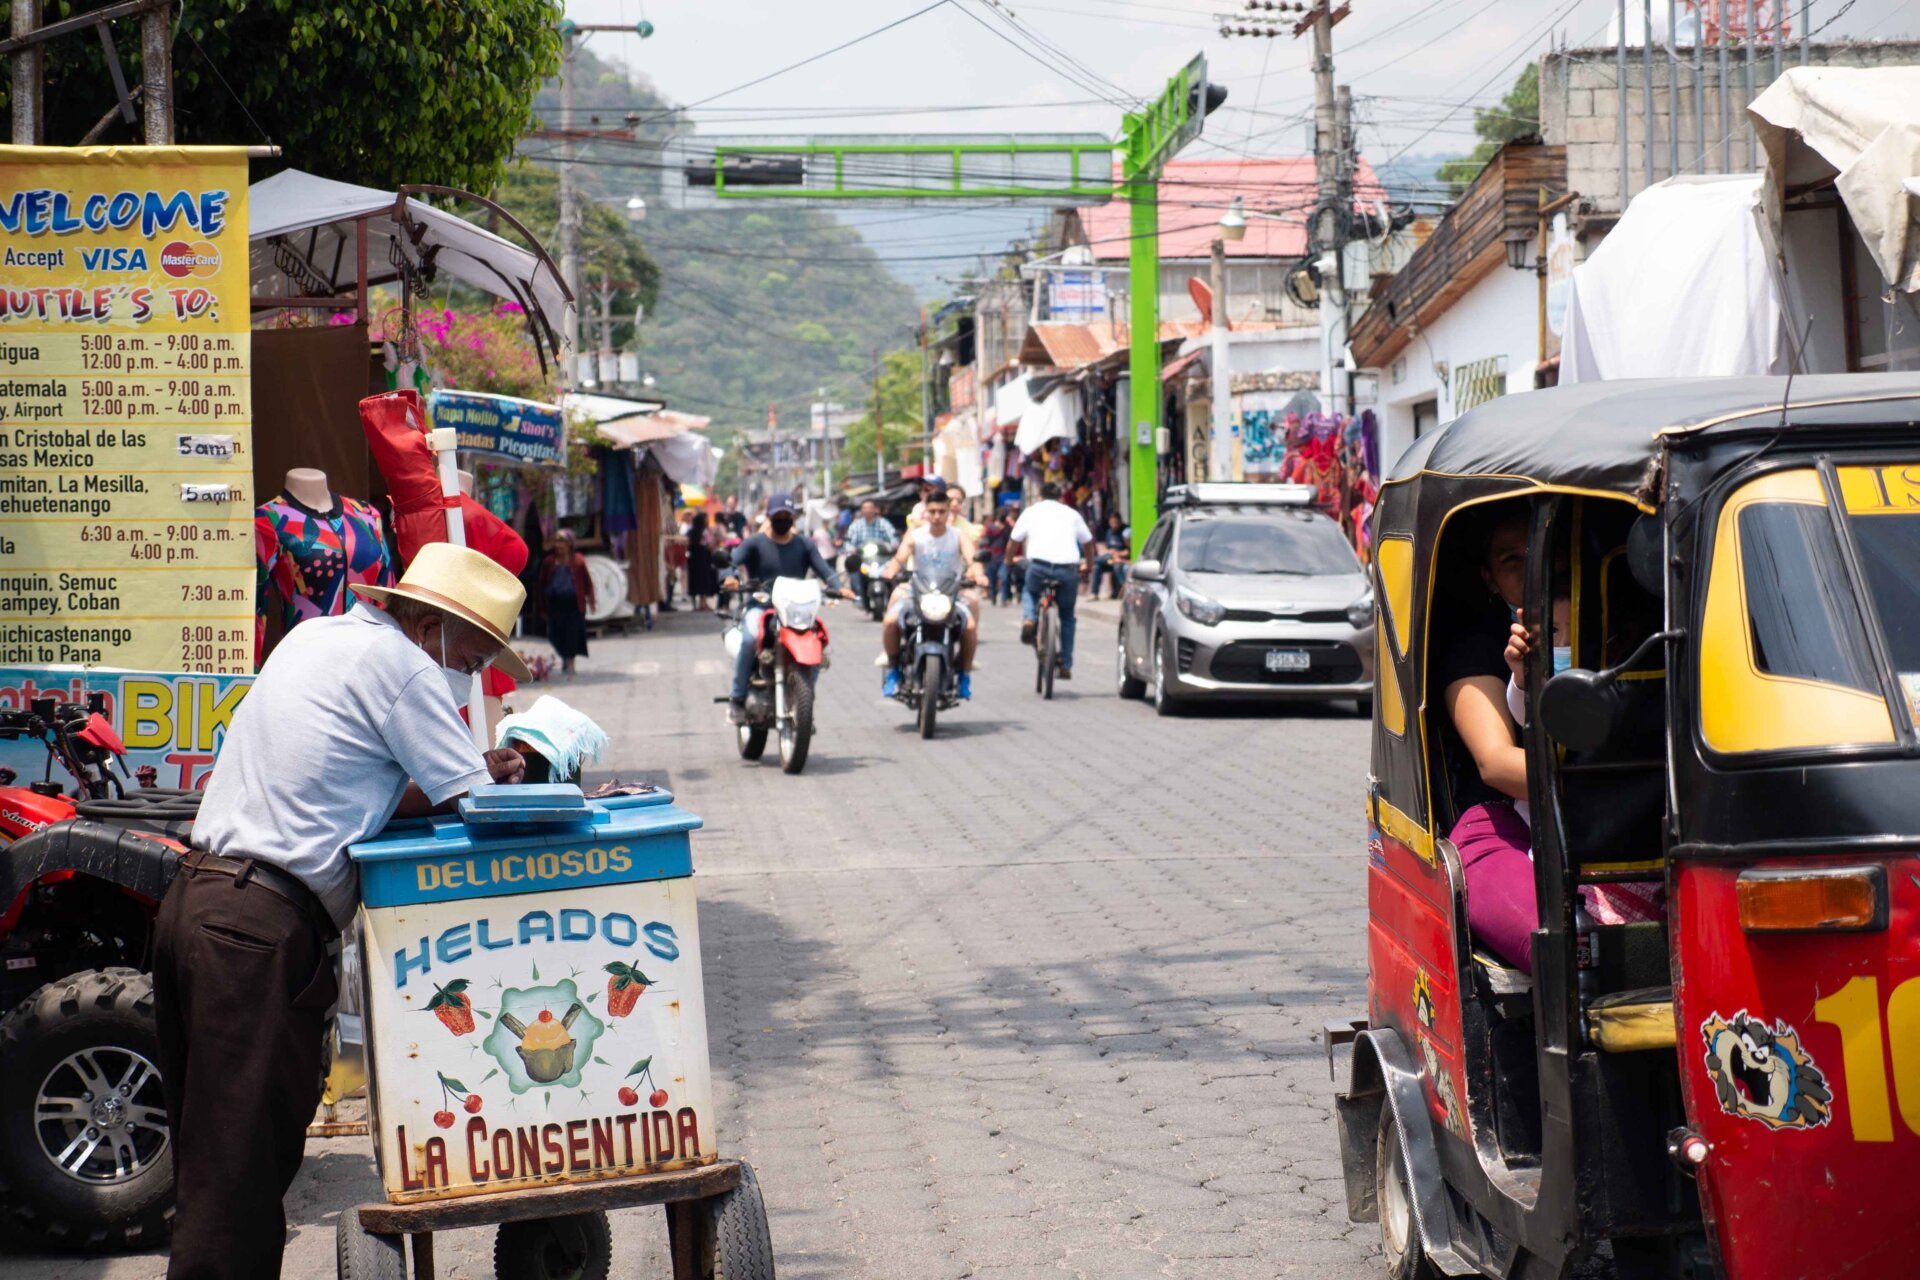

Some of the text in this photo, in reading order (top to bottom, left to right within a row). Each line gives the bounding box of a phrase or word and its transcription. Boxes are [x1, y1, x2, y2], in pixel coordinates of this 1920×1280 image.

[4, 248, 219, 271] Accept VISA MasterCard
[169, 287, 218, 321] TO:
[81, 335, 112, 350] 5:00
[117, 339, 148, 350] a.m.
[168, 335, 198, 350] 9:00
[204, 339, 234, 350] a.m.
[82, 353, 121, 369] 12:00
[127, 358, 158, 373] p.m.
[177, 353, 208, 369] 4:00
[214, 358, 243, 373] p.m.
[82, 381, 113, 396] 5:00
[118, 385, 149, 396] a.m.
[169, 381, 199, 396] 9:00
[205, 385, 235, 396] a.m.
[14, 402, 63, 420] Airport
[83, 399, 122, 415] 12:00
[128, 404, 158, 419] p.m.
[178, 399, 209, 414] 4:00
[215, 404, 243, 419] p.m.
[15, 429, 91, 447] Cristobal
[97, 429, 116, 447] de
[122, 429, 146, 447] las
[34, 449, 93, 467] Mexico
[59, 475, 78, 492] La
[85, 475, 148, 493] Mesilla,
[0, 495, 110, 517] ehuetenango
[81, 526, 111, 541] 6:30
[117, 530, 147, 541] a.m.
[167, 525, 197, 541] 9:00
[203, 529, 234, 540] a.m.
[131, 544, 198, 563] 4:00 p.m.
[1, 573, 116, 596] nquin, Semuc
[182, 585, 247, 601] 7:30 a.m.
[2, 593, 119, 615] ampey, Coban
[182, 626, 247, 642] 8:00 a.m.
[38, 646, 53, 662] to
[60, 644, 100, 662] Pana
[182, 645, 247, 664] 2:00 p.m.
[415, 845, 633, 892] DELICIOSOS
[394, 908, 680, 991] HELADOS
[397, 1105, 701, 1193] LA CONSENTIDA
